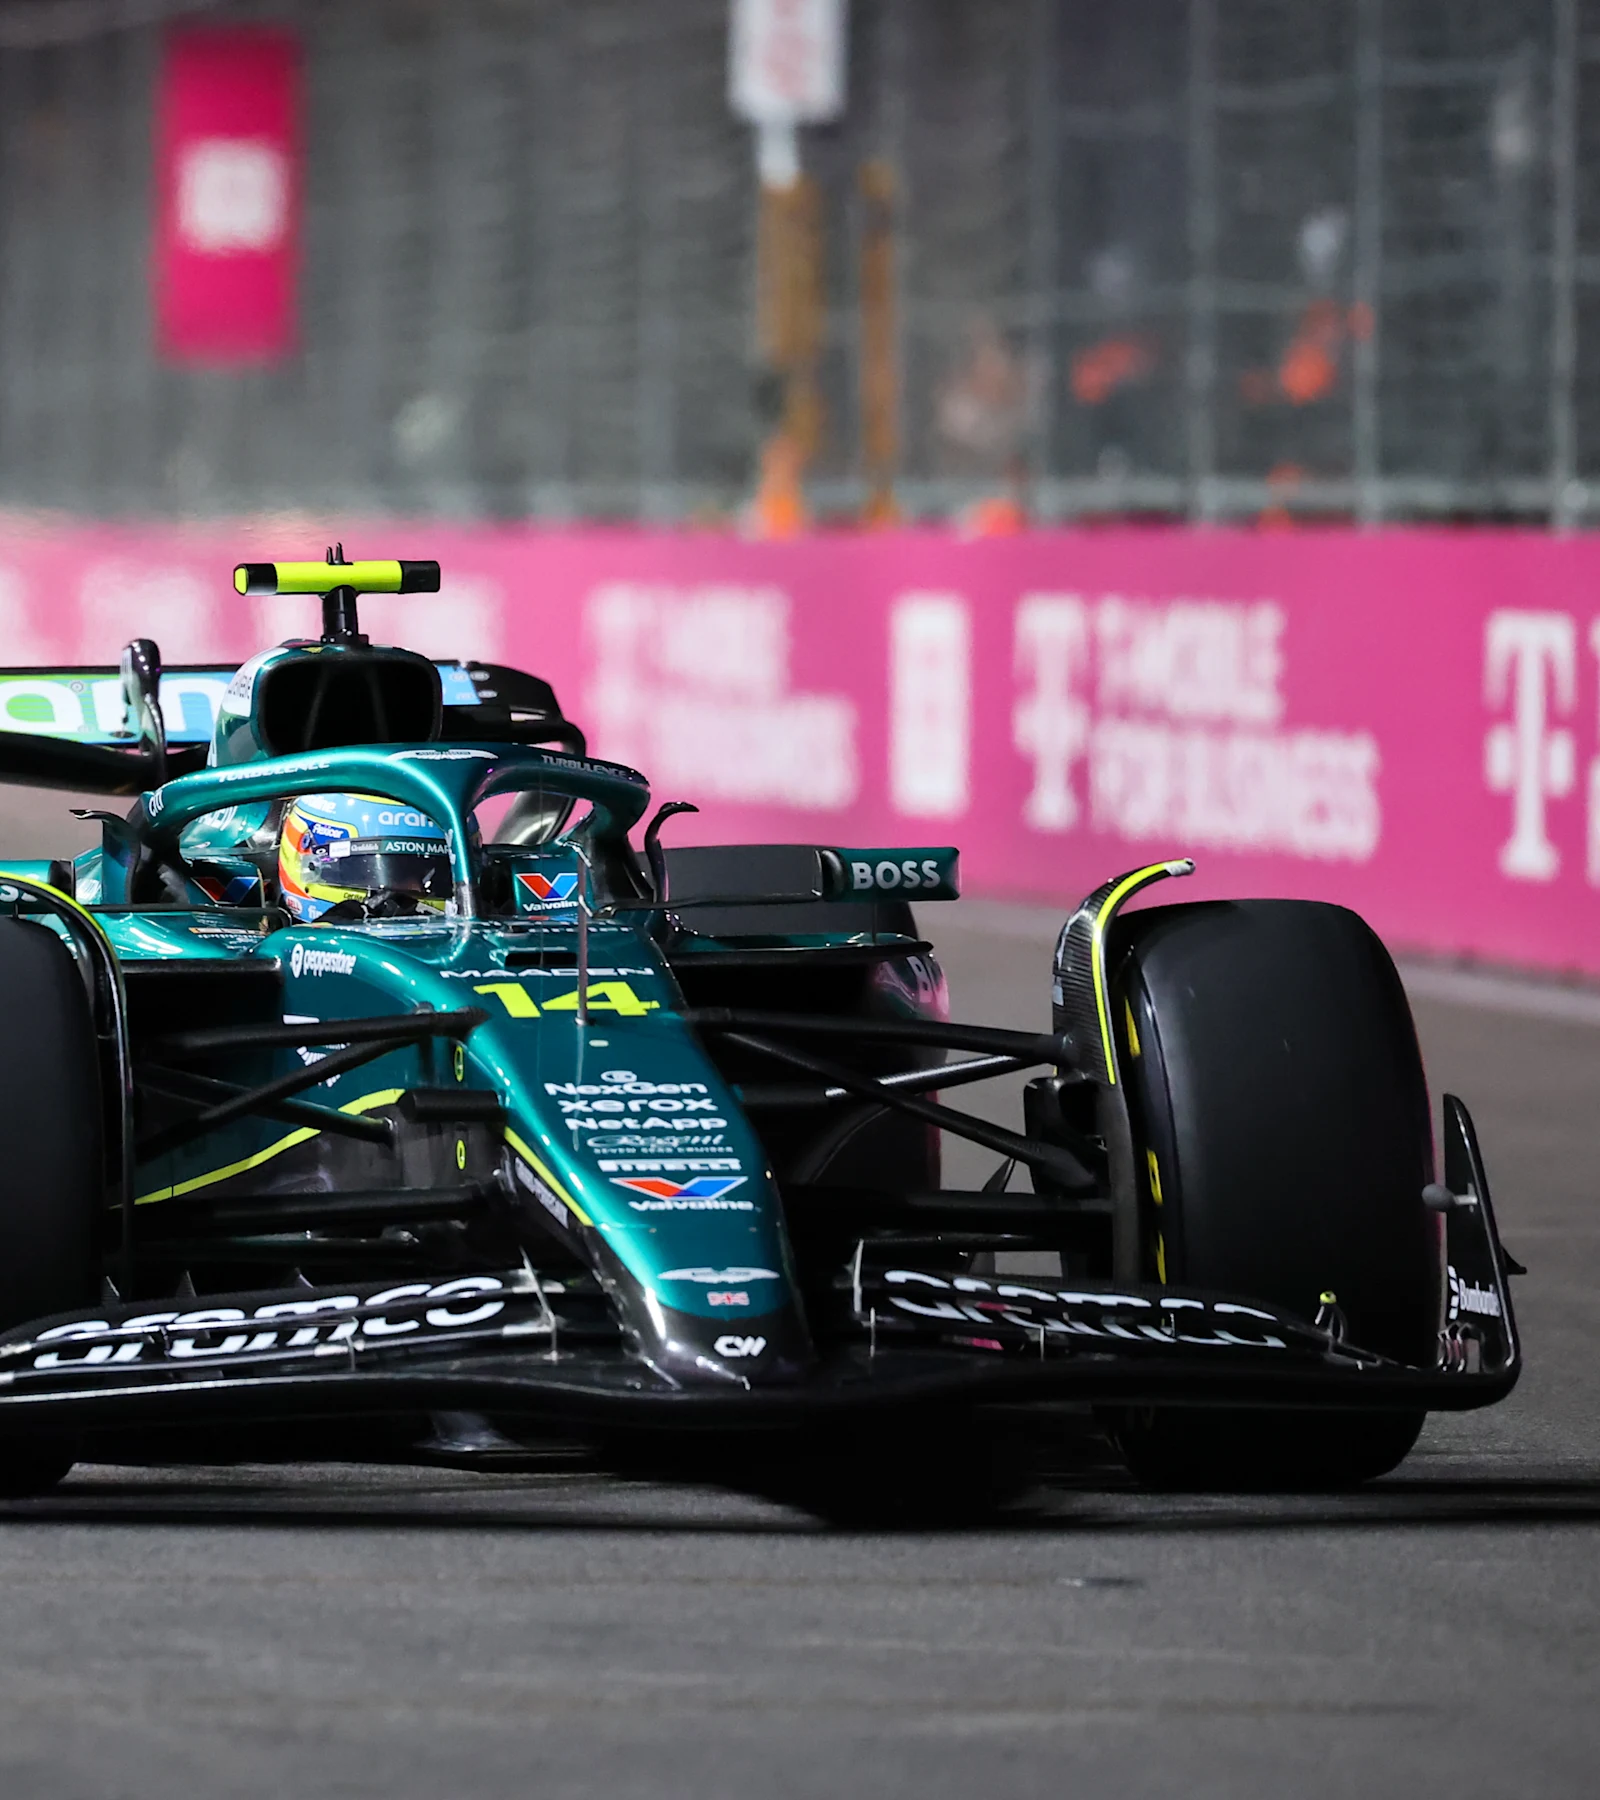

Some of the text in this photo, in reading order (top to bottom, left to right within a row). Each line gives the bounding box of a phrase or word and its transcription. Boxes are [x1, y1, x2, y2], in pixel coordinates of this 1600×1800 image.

[541, 754, 627, 778] TURBULENCE
[385, 841, 424, 853] ASTON
[851, 860, 941, 889] BOSS
[304, 949, 357, 977] pepperstone
[439, 967, 655, 979] MAADEN
[473, 981, 661, 1018] 14
[543, 1081, 708, 1096] NexGen
[557, 1098, 719, 1113] xerox
[564, 1116, 728, 1131] NetApp
[597, 1158, 742, 1172] PIRELLI
[33, 1276, 504, 1369] aramco
